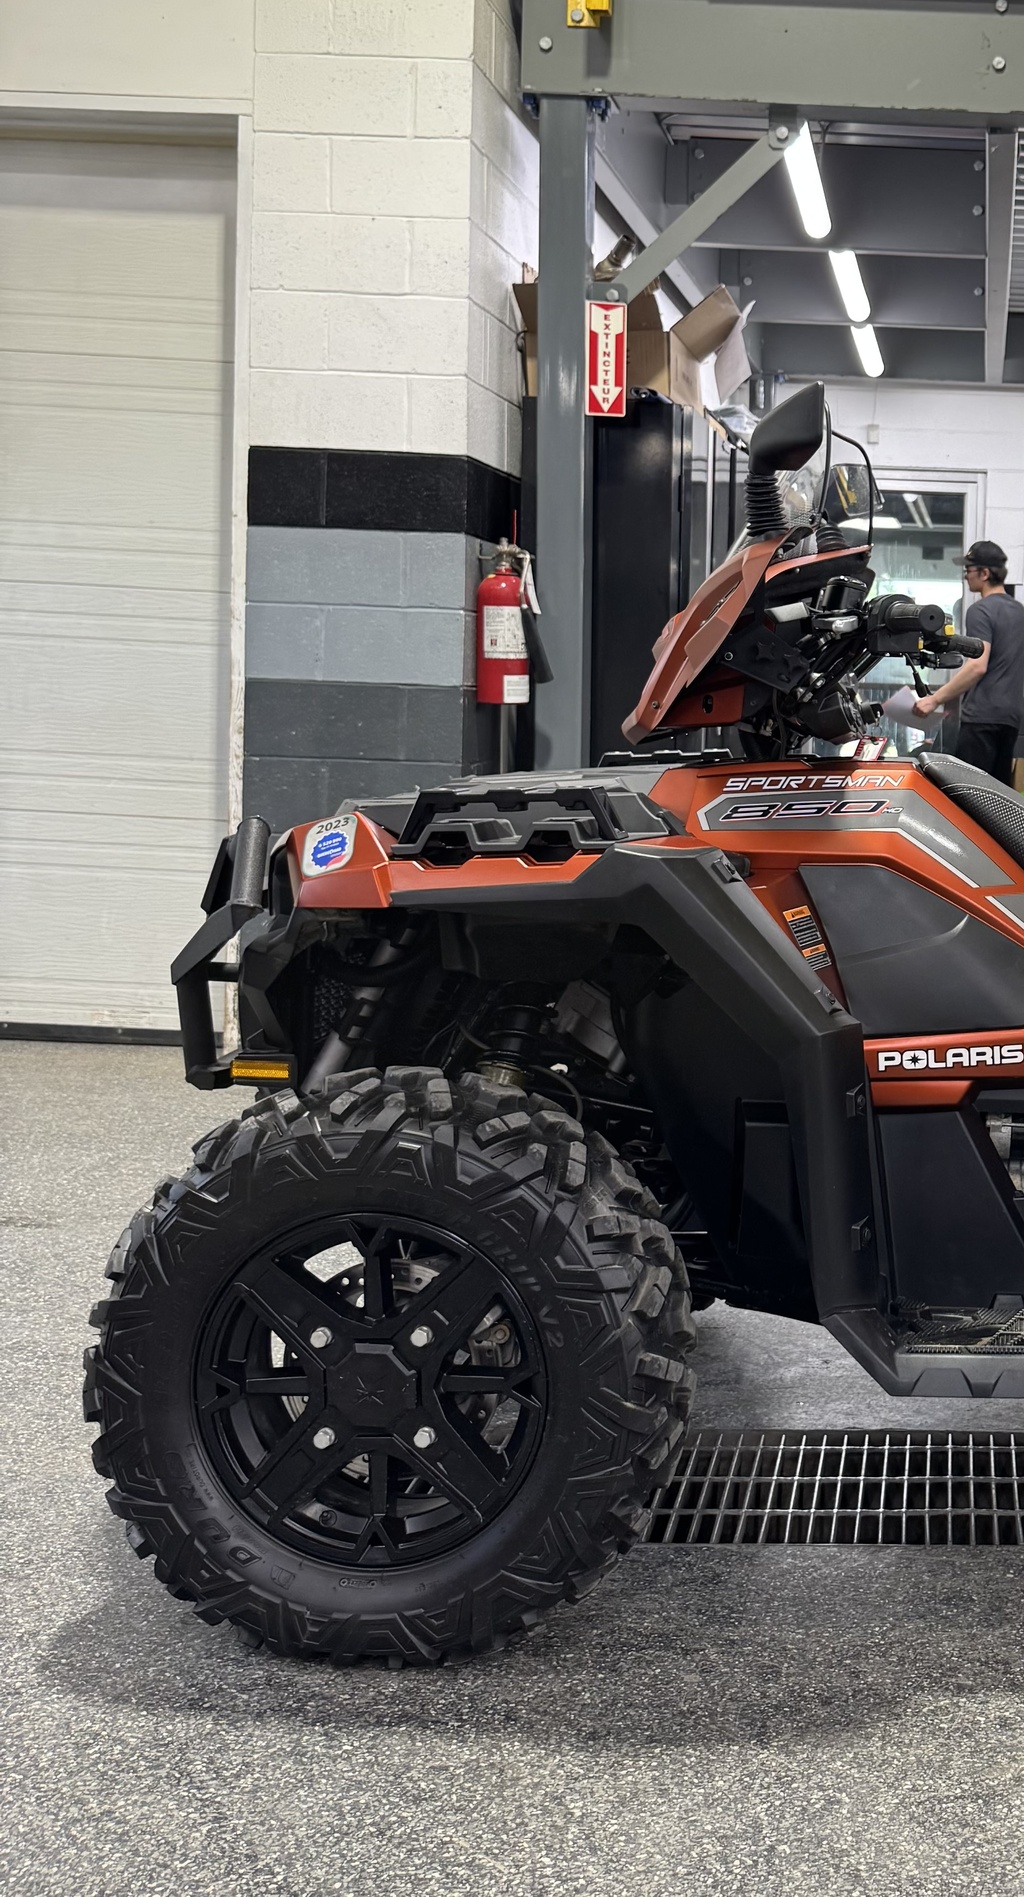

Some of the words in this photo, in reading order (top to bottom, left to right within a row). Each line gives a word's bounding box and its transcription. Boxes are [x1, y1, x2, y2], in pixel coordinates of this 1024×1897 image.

[602, 314, 611, 404] EXTINCTEUR
[722, 775, 906, 792] SPORTSMAN
[719, 799, 890, 822] 850
[881, 806, 904, 815] HO
[316, 817, 350, 835] 2023
[877, 1044, 1024, 1072] POLARIS
[537, 1304, 565, 1349] V2
[163, 1450, 262, 1567] DURO
